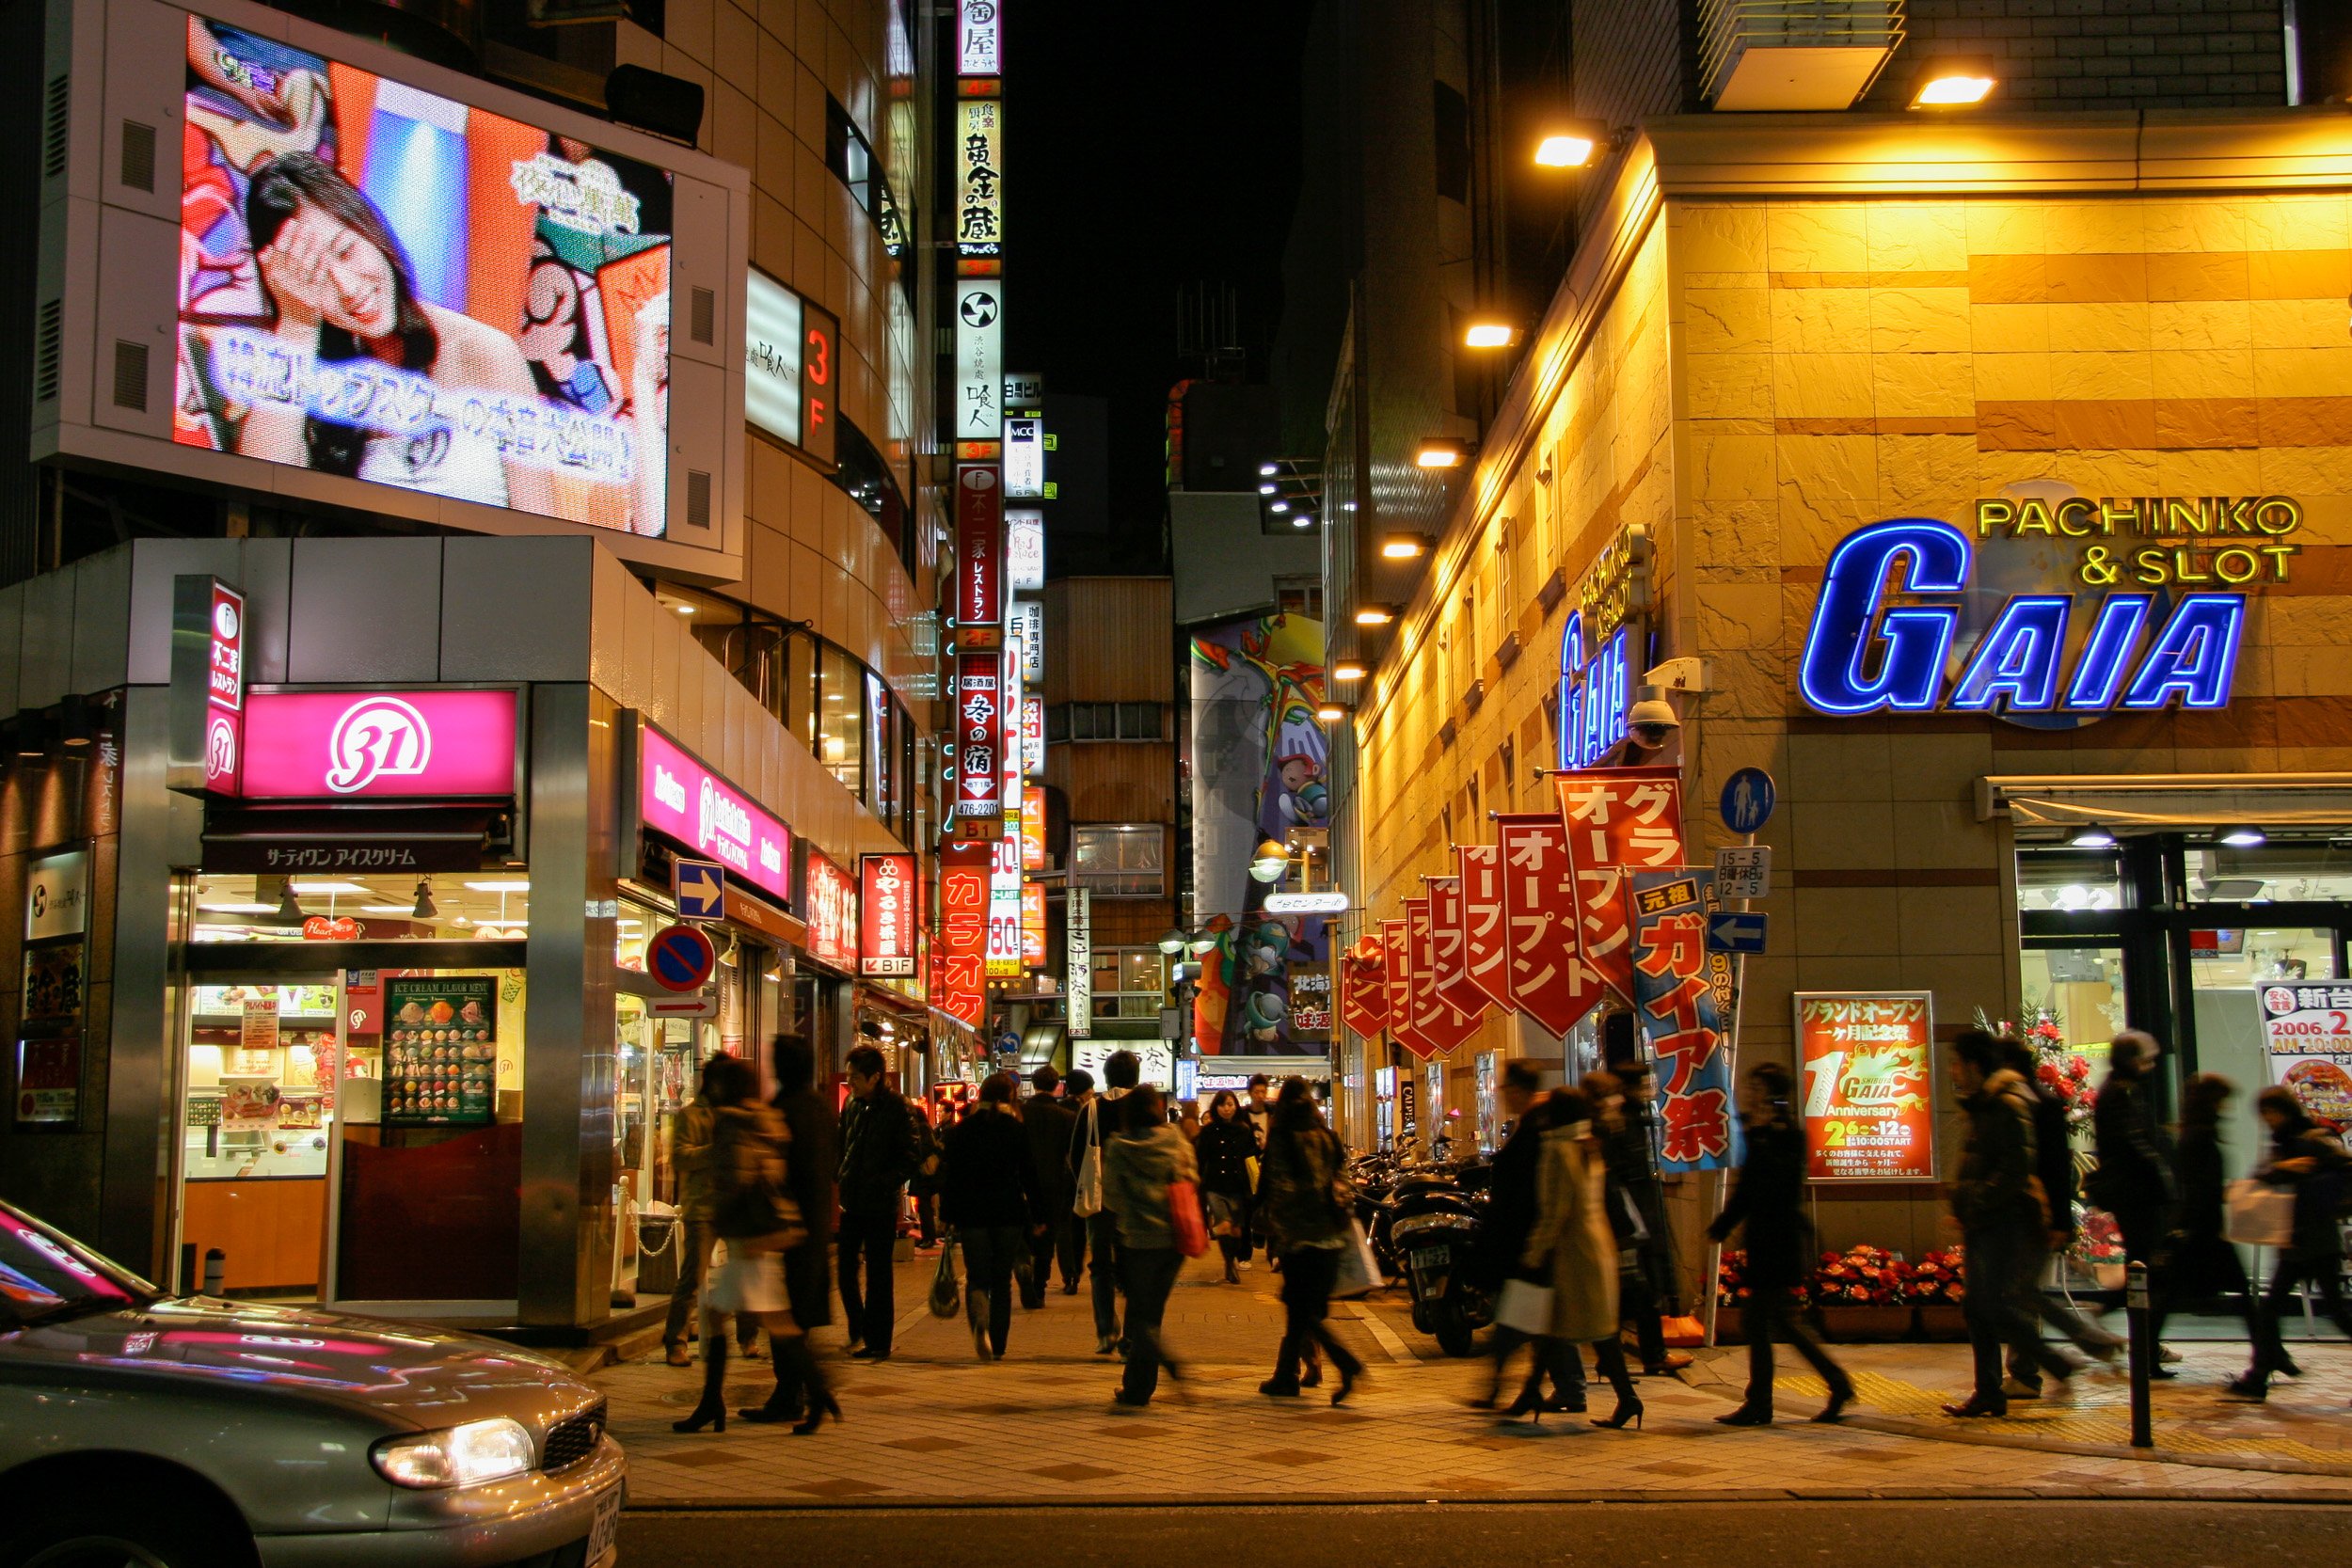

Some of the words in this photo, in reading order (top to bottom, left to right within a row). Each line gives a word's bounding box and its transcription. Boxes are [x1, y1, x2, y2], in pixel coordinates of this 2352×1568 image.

[966, 81, 993, 96] 4F
[961, 133, 1000, 240] 黄金の蔵
[966, 261, 993, 276] 3F
[966, 385, 995, 428] 喰人
[1010, 427, 1034, 437] MCC
[965, 442, 993, 459] 3F
[971, 494, 987, 560] 不二家
[1976, 496, 2303, 539] PACHINKO
[2080, 544, 2118, 586] &
[2136, 544, 2301, 585] SLOT
[973, 562, 985, 622] レストラン
[1798, 516, 2248, 715] GAIA
[965, 631, 993, 646] 2F
[213, 640, 239, 674] 不二家
[212, 669, 237, 697] レストラン
[962, 677, 994, 689] 居酒屋
[1559, 608, 1629, 770] GAIA
[964, 694, 993, 773] 冬の宿
[328, 712, 418, 791] 31
[958, 802, 999, 816] 476-2201
[965, 821, 989, 838] B1
[267, 848, 331, 866] サーティワン
[335, 848, 416, 866] アイスクリーム
[1568, 784, 1630, 959] オープン
[1644, 882, 1691, 910] 元祖
[875, 876, 900, 956] やるき茶屋
[1509, 831, 1556, 998] オープン
[308, 921, 334, 936] Heart
[945, 871, 985, 1024] カラオケ
[882, 959, 911, 972] B1F
[394, 984, 408, 993] ICE
[410, 984, 439, 993] CREAM
[442, 984, 467, 992] FLAVOR
[2268, 990, 2290, 1000] 安心
[1804, 1000, 1925, 1023] グランドオープン
[1636, 911, 1729, 1163] ガイア祭
[2272, 1037, 2299, 1053] AM
[2334, 1055, 2350, 1065] 2F
[1843, 1076, 1892, 1099] GAIA
[1826, 1104, 1899, 1119] Anniversary
